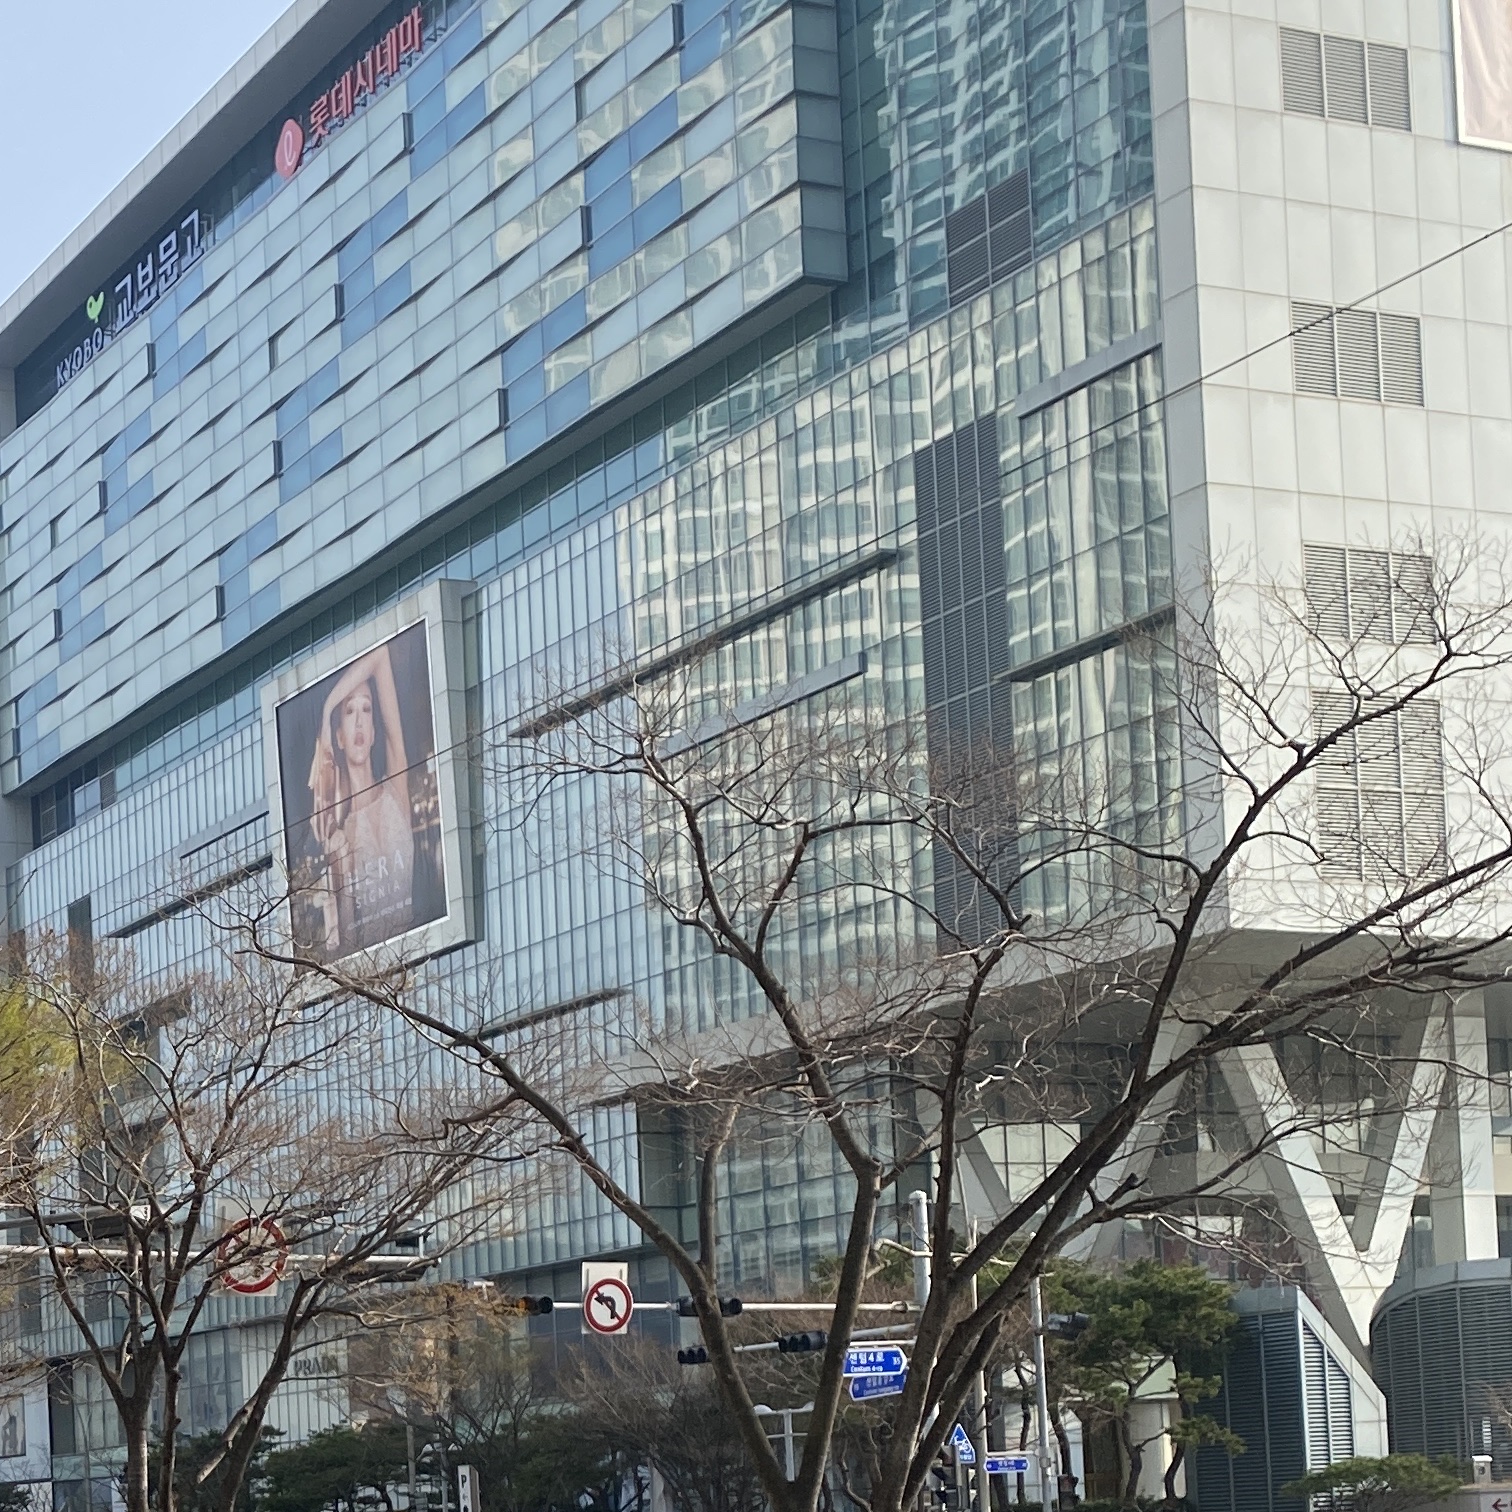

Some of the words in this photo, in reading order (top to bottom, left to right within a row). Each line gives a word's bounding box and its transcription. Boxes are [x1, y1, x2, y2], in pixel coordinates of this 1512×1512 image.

[309, 5, 423, 143] 롯데시네마
[115, 209, 203, 334] 교보문고
[56, 327, 104, 387] KYOBO
[349, 850, 404, 893] HERA
[356, 880, 400, 909] SIGNIA
[849, 1352, 884, 1364] 센텀4로
